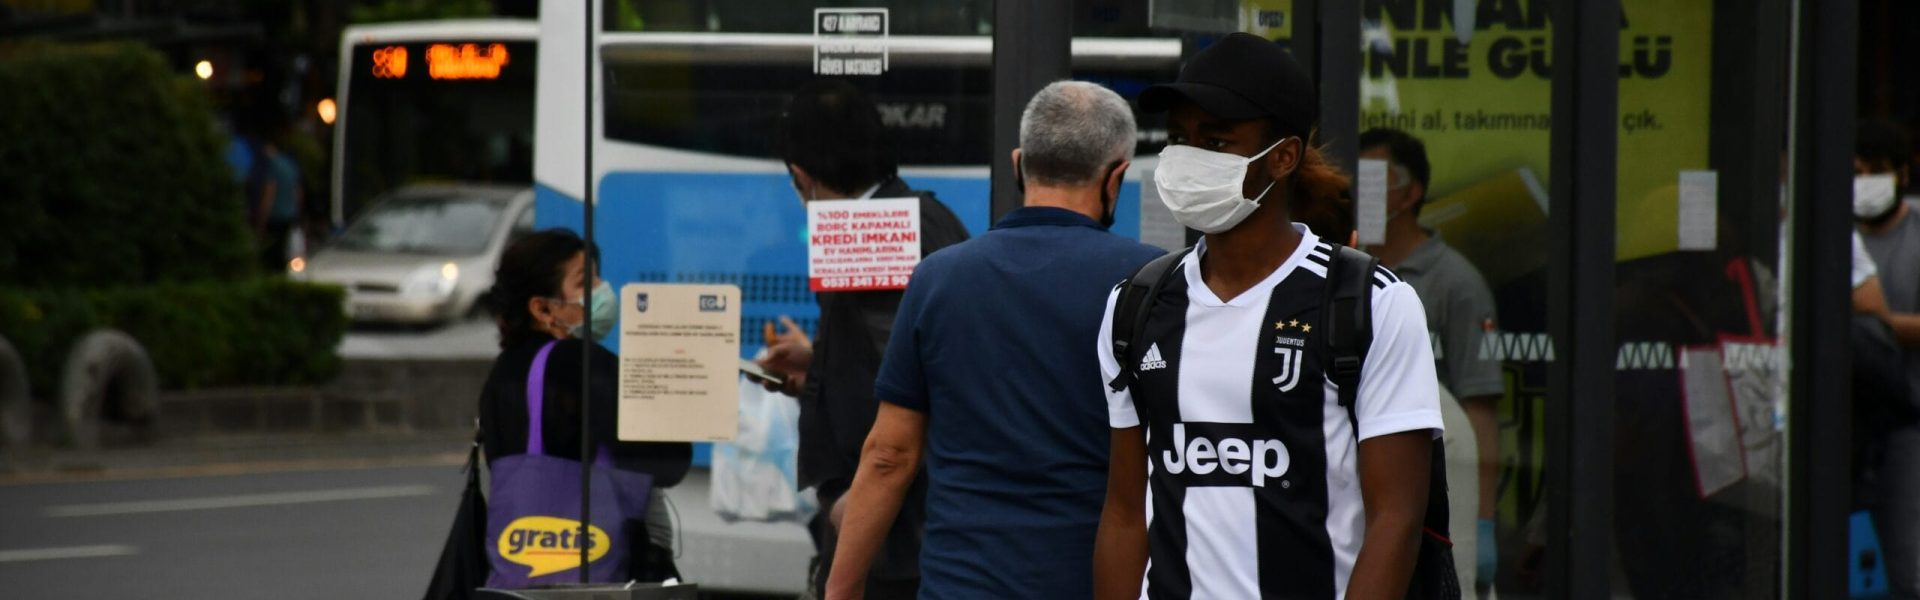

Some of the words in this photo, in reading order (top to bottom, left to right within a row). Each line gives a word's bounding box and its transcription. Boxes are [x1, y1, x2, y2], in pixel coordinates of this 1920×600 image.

[811, 232, 858, 246] KREDİ
[861, 231, 917, 245] İMKANI
[821, 277, 850, 289] 0531
[851, 276, 873, 289] 241
[875, 276, 890, 288] 72
[890, 275, 909, 287] 90
[1276, 335, 1305, 347] JUVENTUS
[1140, 359, 1168, 371] adidas
[1162, 422, 1291, 488] Jeep
[508, 526, 597, 555] gratis
